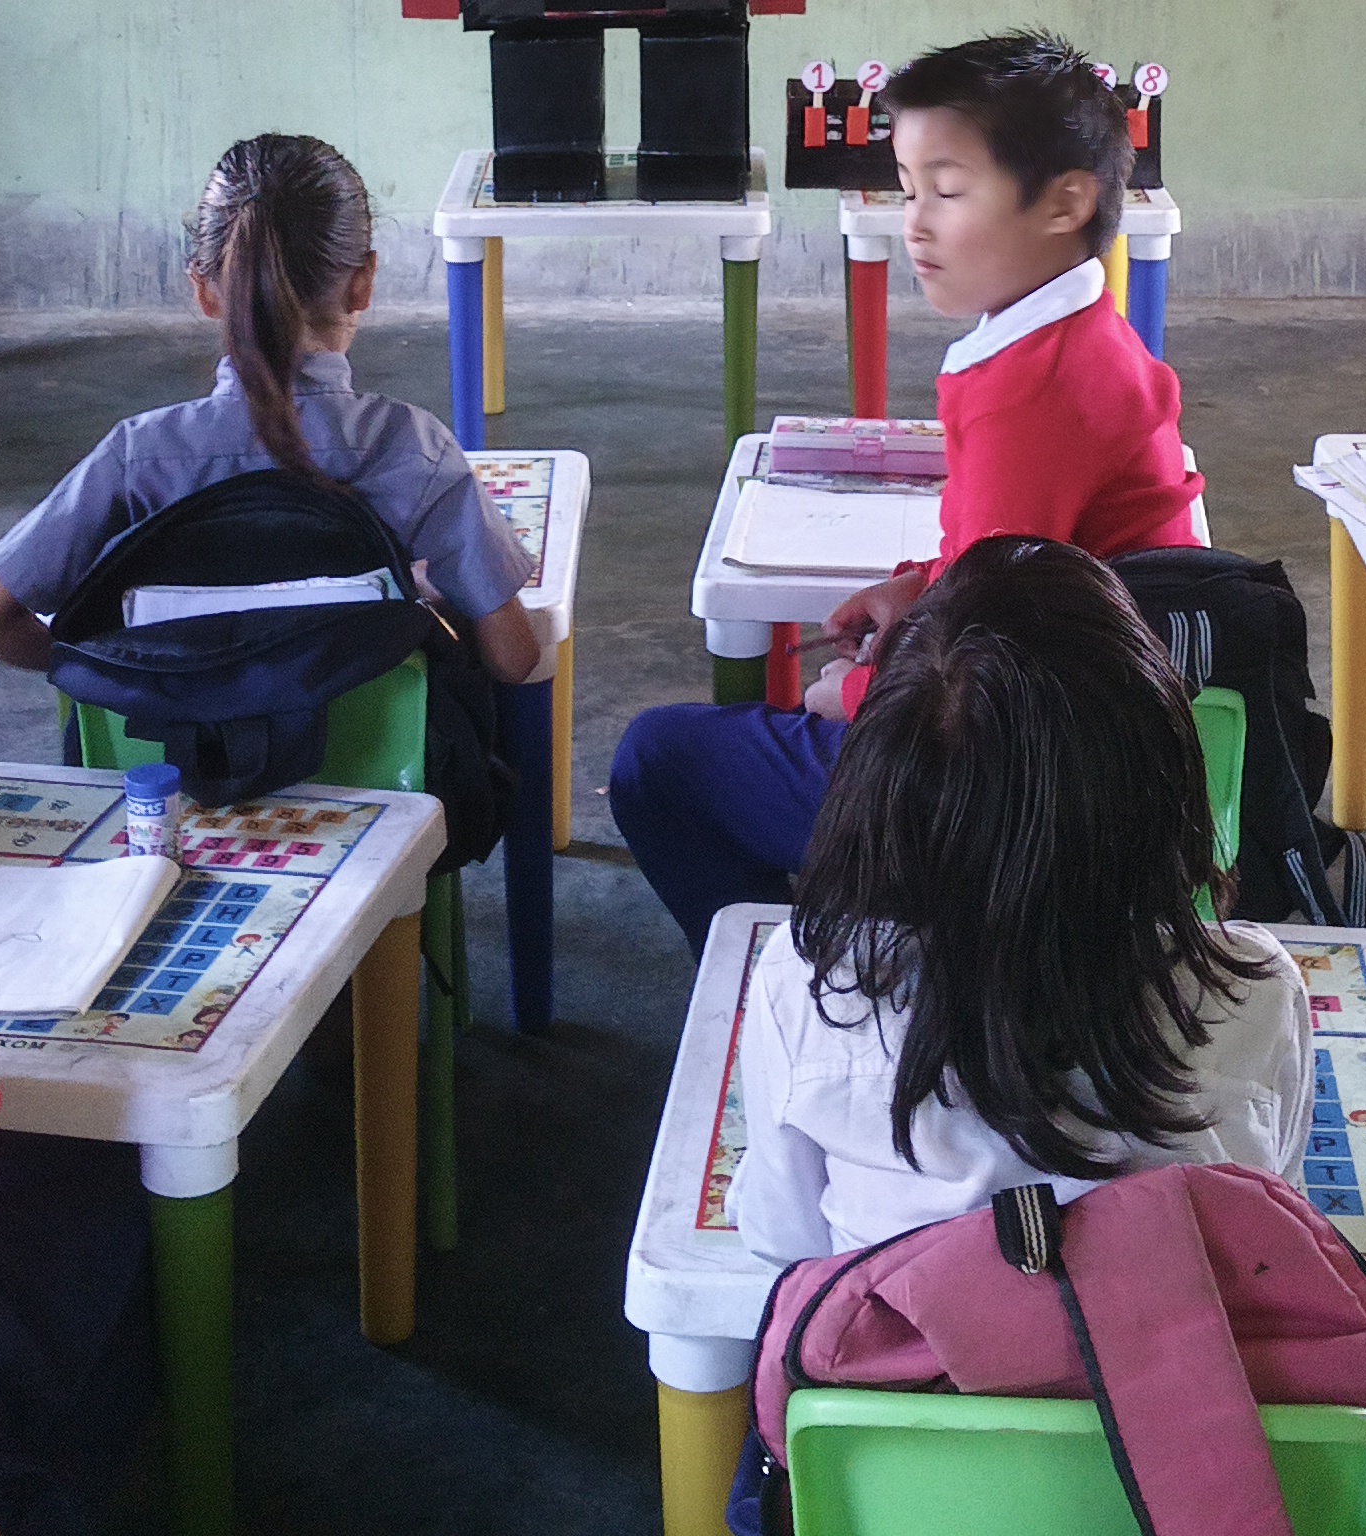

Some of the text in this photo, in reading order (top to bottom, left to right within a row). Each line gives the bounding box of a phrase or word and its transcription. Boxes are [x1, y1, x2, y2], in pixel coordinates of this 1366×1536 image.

[812, 63, 825, 89] 1
[862, 63, 882, 90] 2
[1142, 65, 1161, 92] 8
[296, 842, 314, 855] 5
[260, 854, 279, 867] 9
[236, 885, 258, 899] D
[217, 906, 243, 921] H
[200, 929, 218, 944] L
[181, 952, 205, 965] P
[168, 974, 189, 989] T
[141, 995, 169, 1011] X
[1313, 1135, 1337, 1153] P
[1315, 1165, 1343, 1182] T
[1322, 1192, 1351, 1211] X
